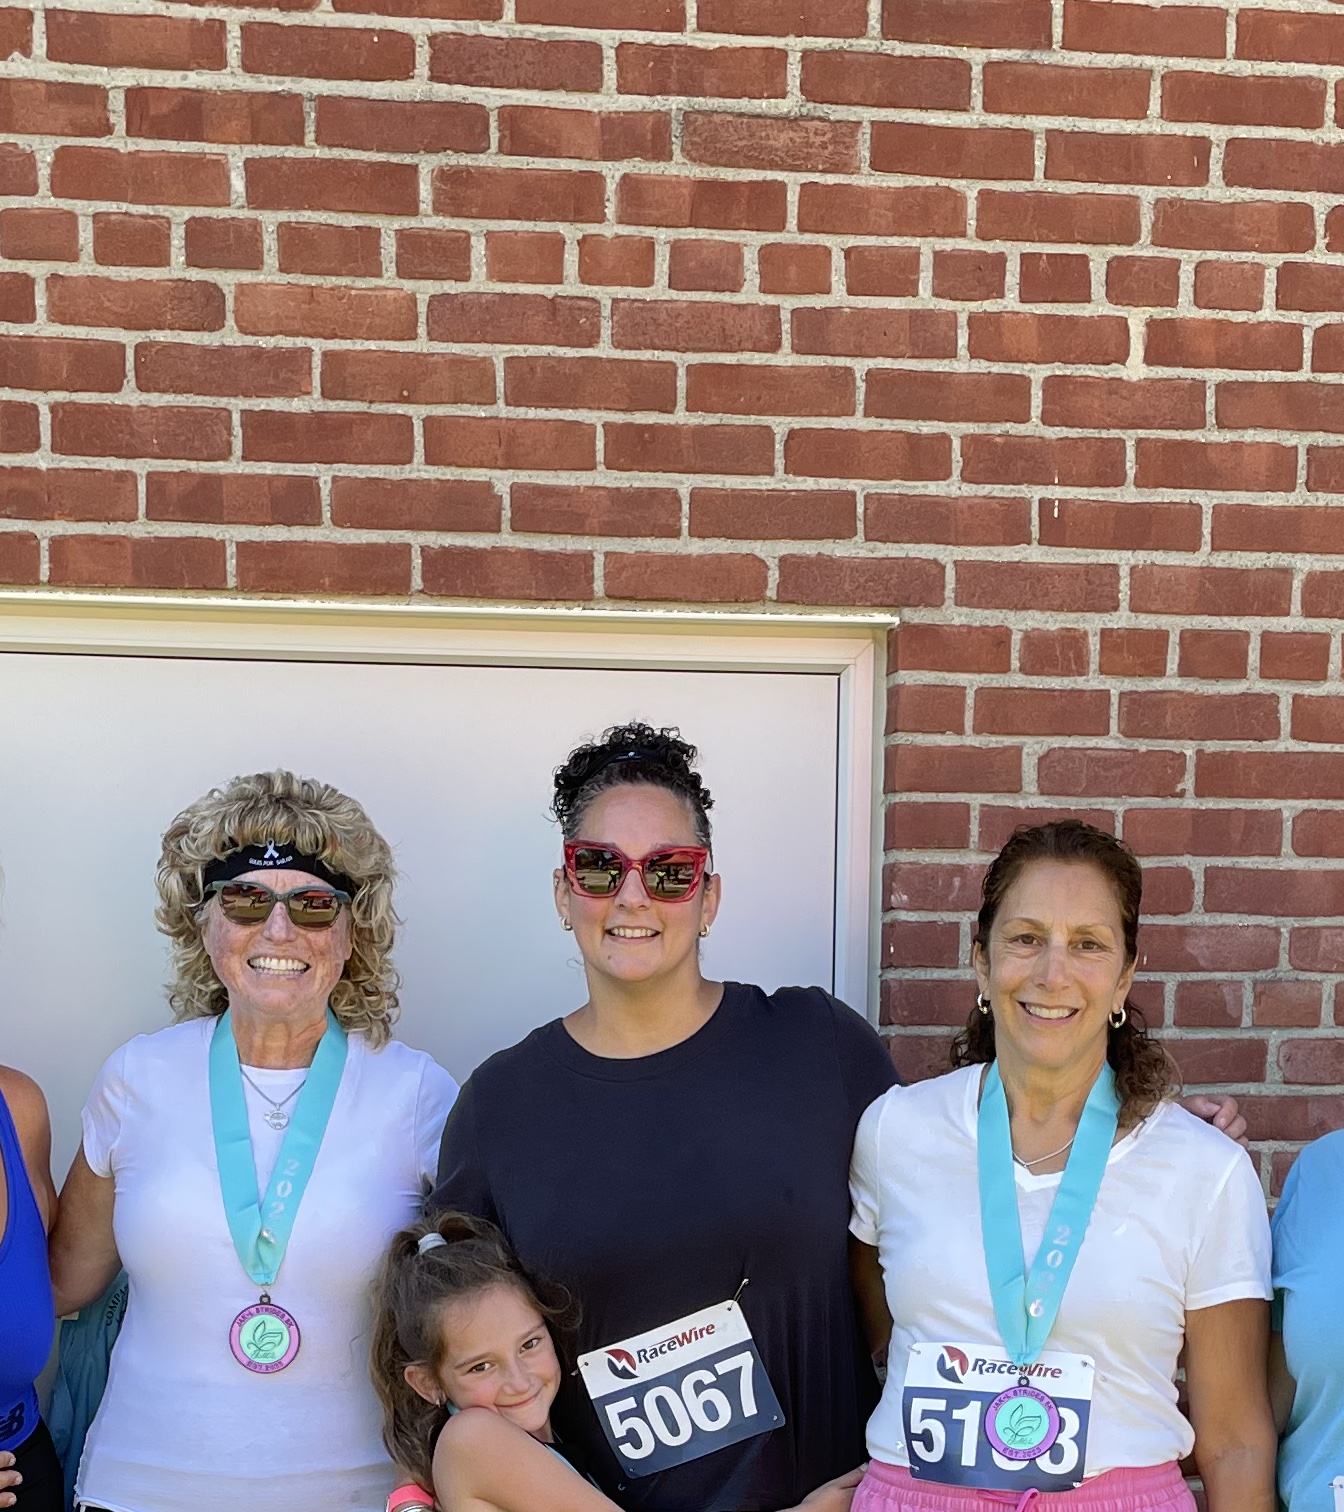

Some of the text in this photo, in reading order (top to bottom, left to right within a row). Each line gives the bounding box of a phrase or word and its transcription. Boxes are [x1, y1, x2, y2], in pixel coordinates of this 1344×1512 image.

[636, 1322, 716, 1364] RaceWire
[604, 1350, 758, 1461] 5067
[910, 1397, 1081, 1475] 518
